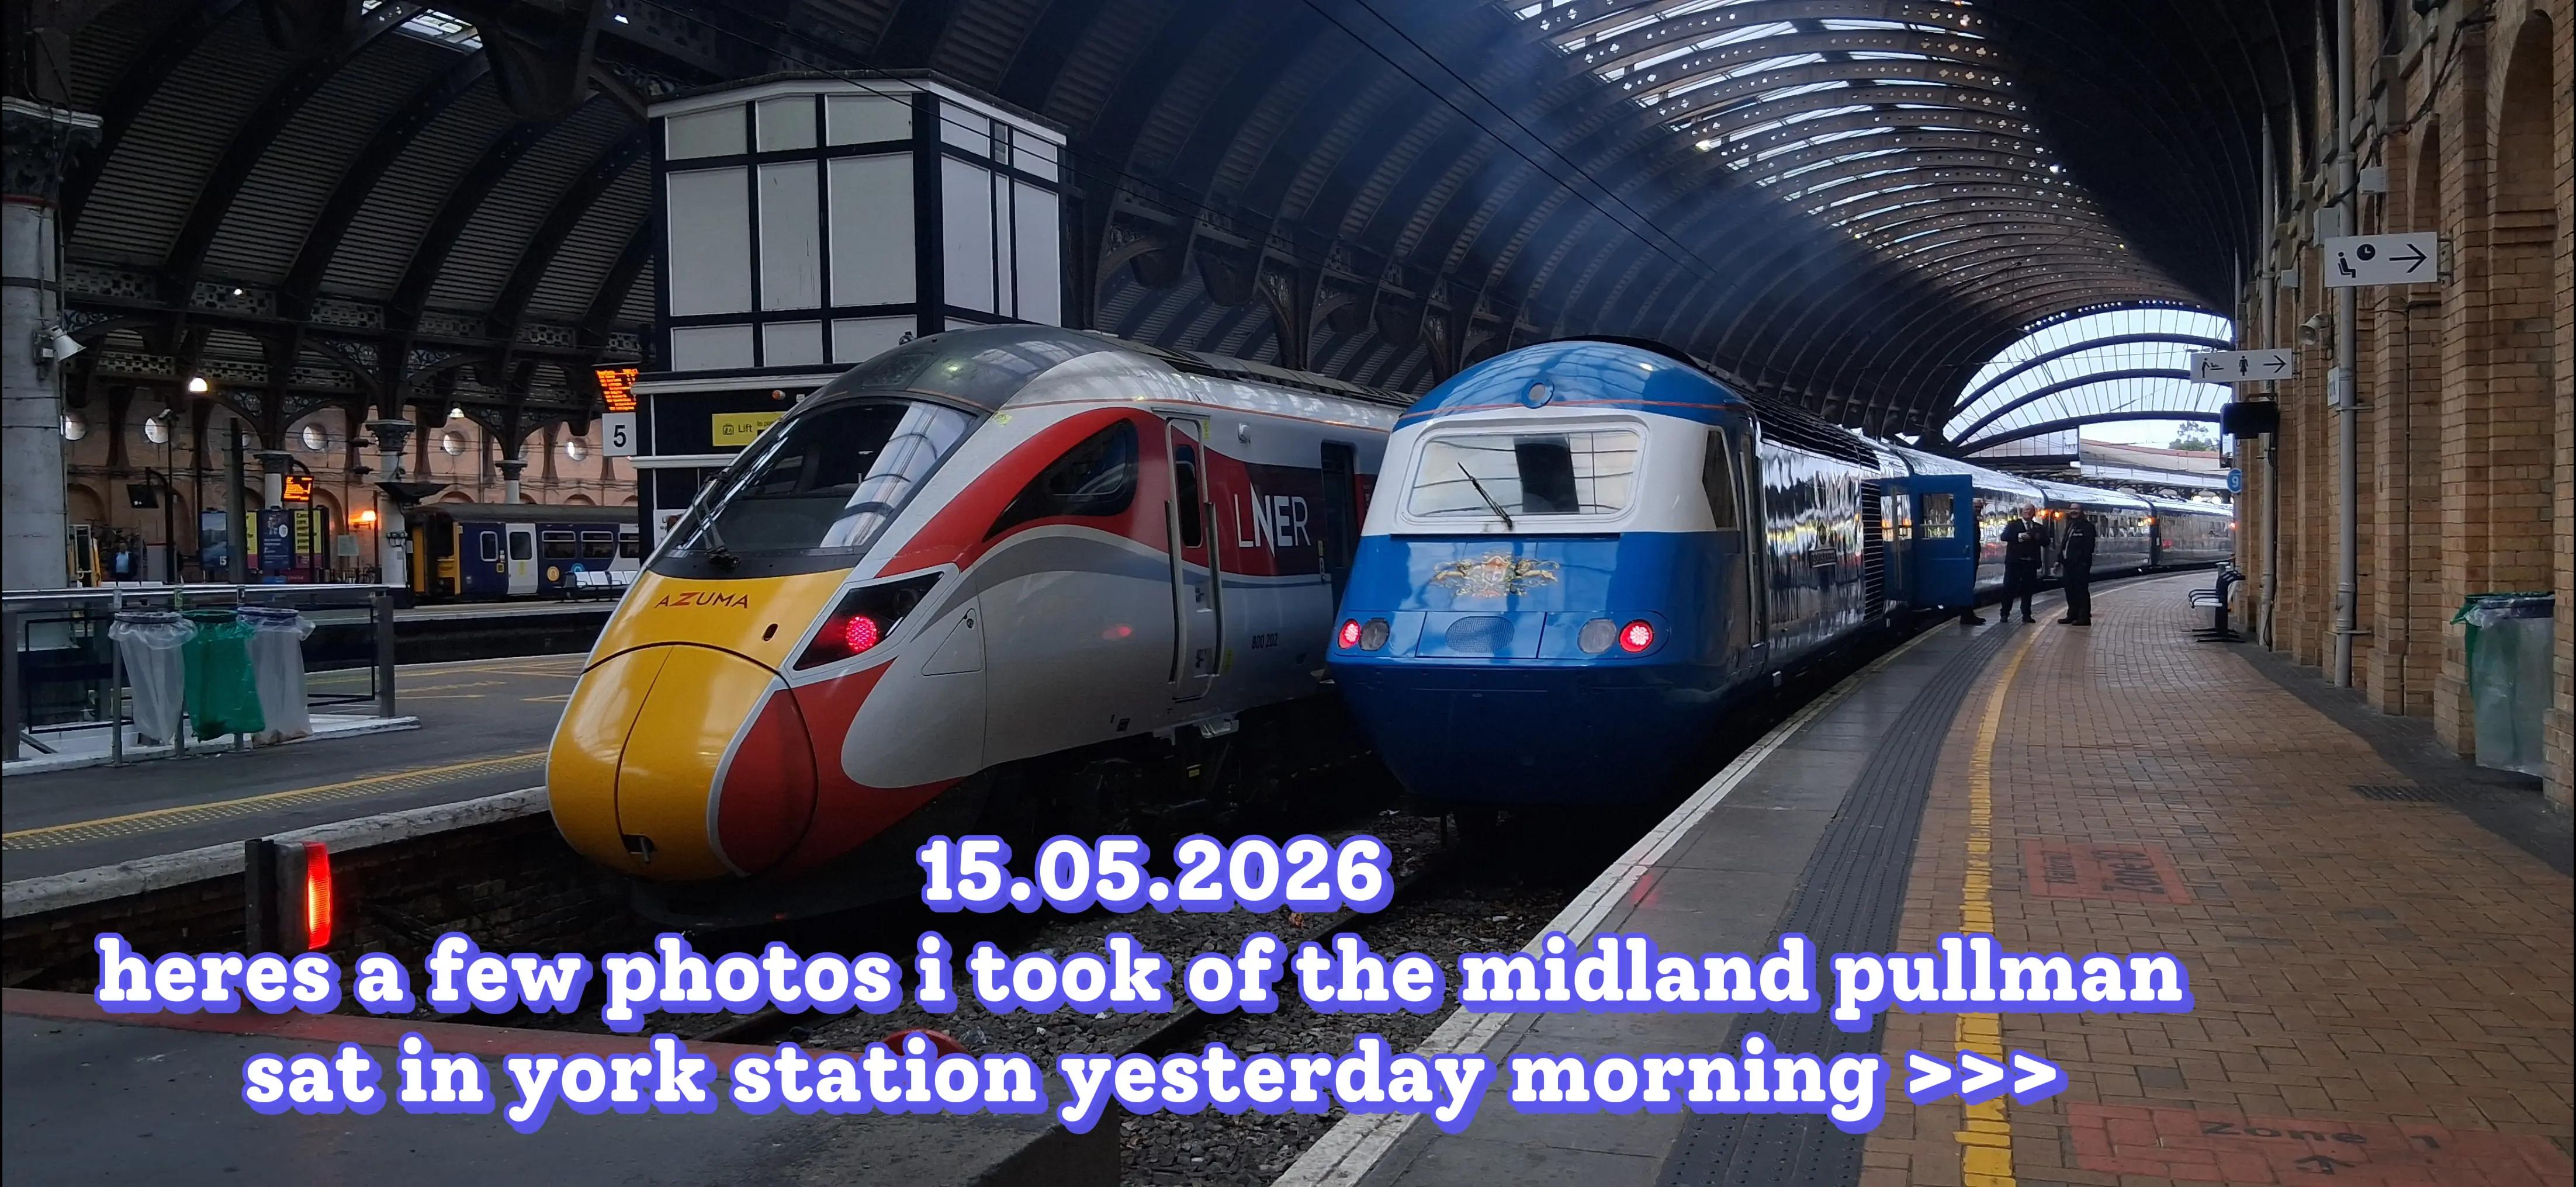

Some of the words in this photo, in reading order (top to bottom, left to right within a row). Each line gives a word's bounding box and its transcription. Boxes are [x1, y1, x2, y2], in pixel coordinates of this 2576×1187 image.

[614, 424, 627, 448] 5
[738, 424, 753, 433] Lift
[2232, 476, 2239, 488] 9
[1234, 481, 1311, 559] LNER
[653, 591, 749, 609] AZUMA
[1252, 634, 1265, 650] 800
[1266, 632, 1279, 647] 202
[2100, 862, 2165, 894] Zone
[2199, 1121, 2367, 1144] Zone
